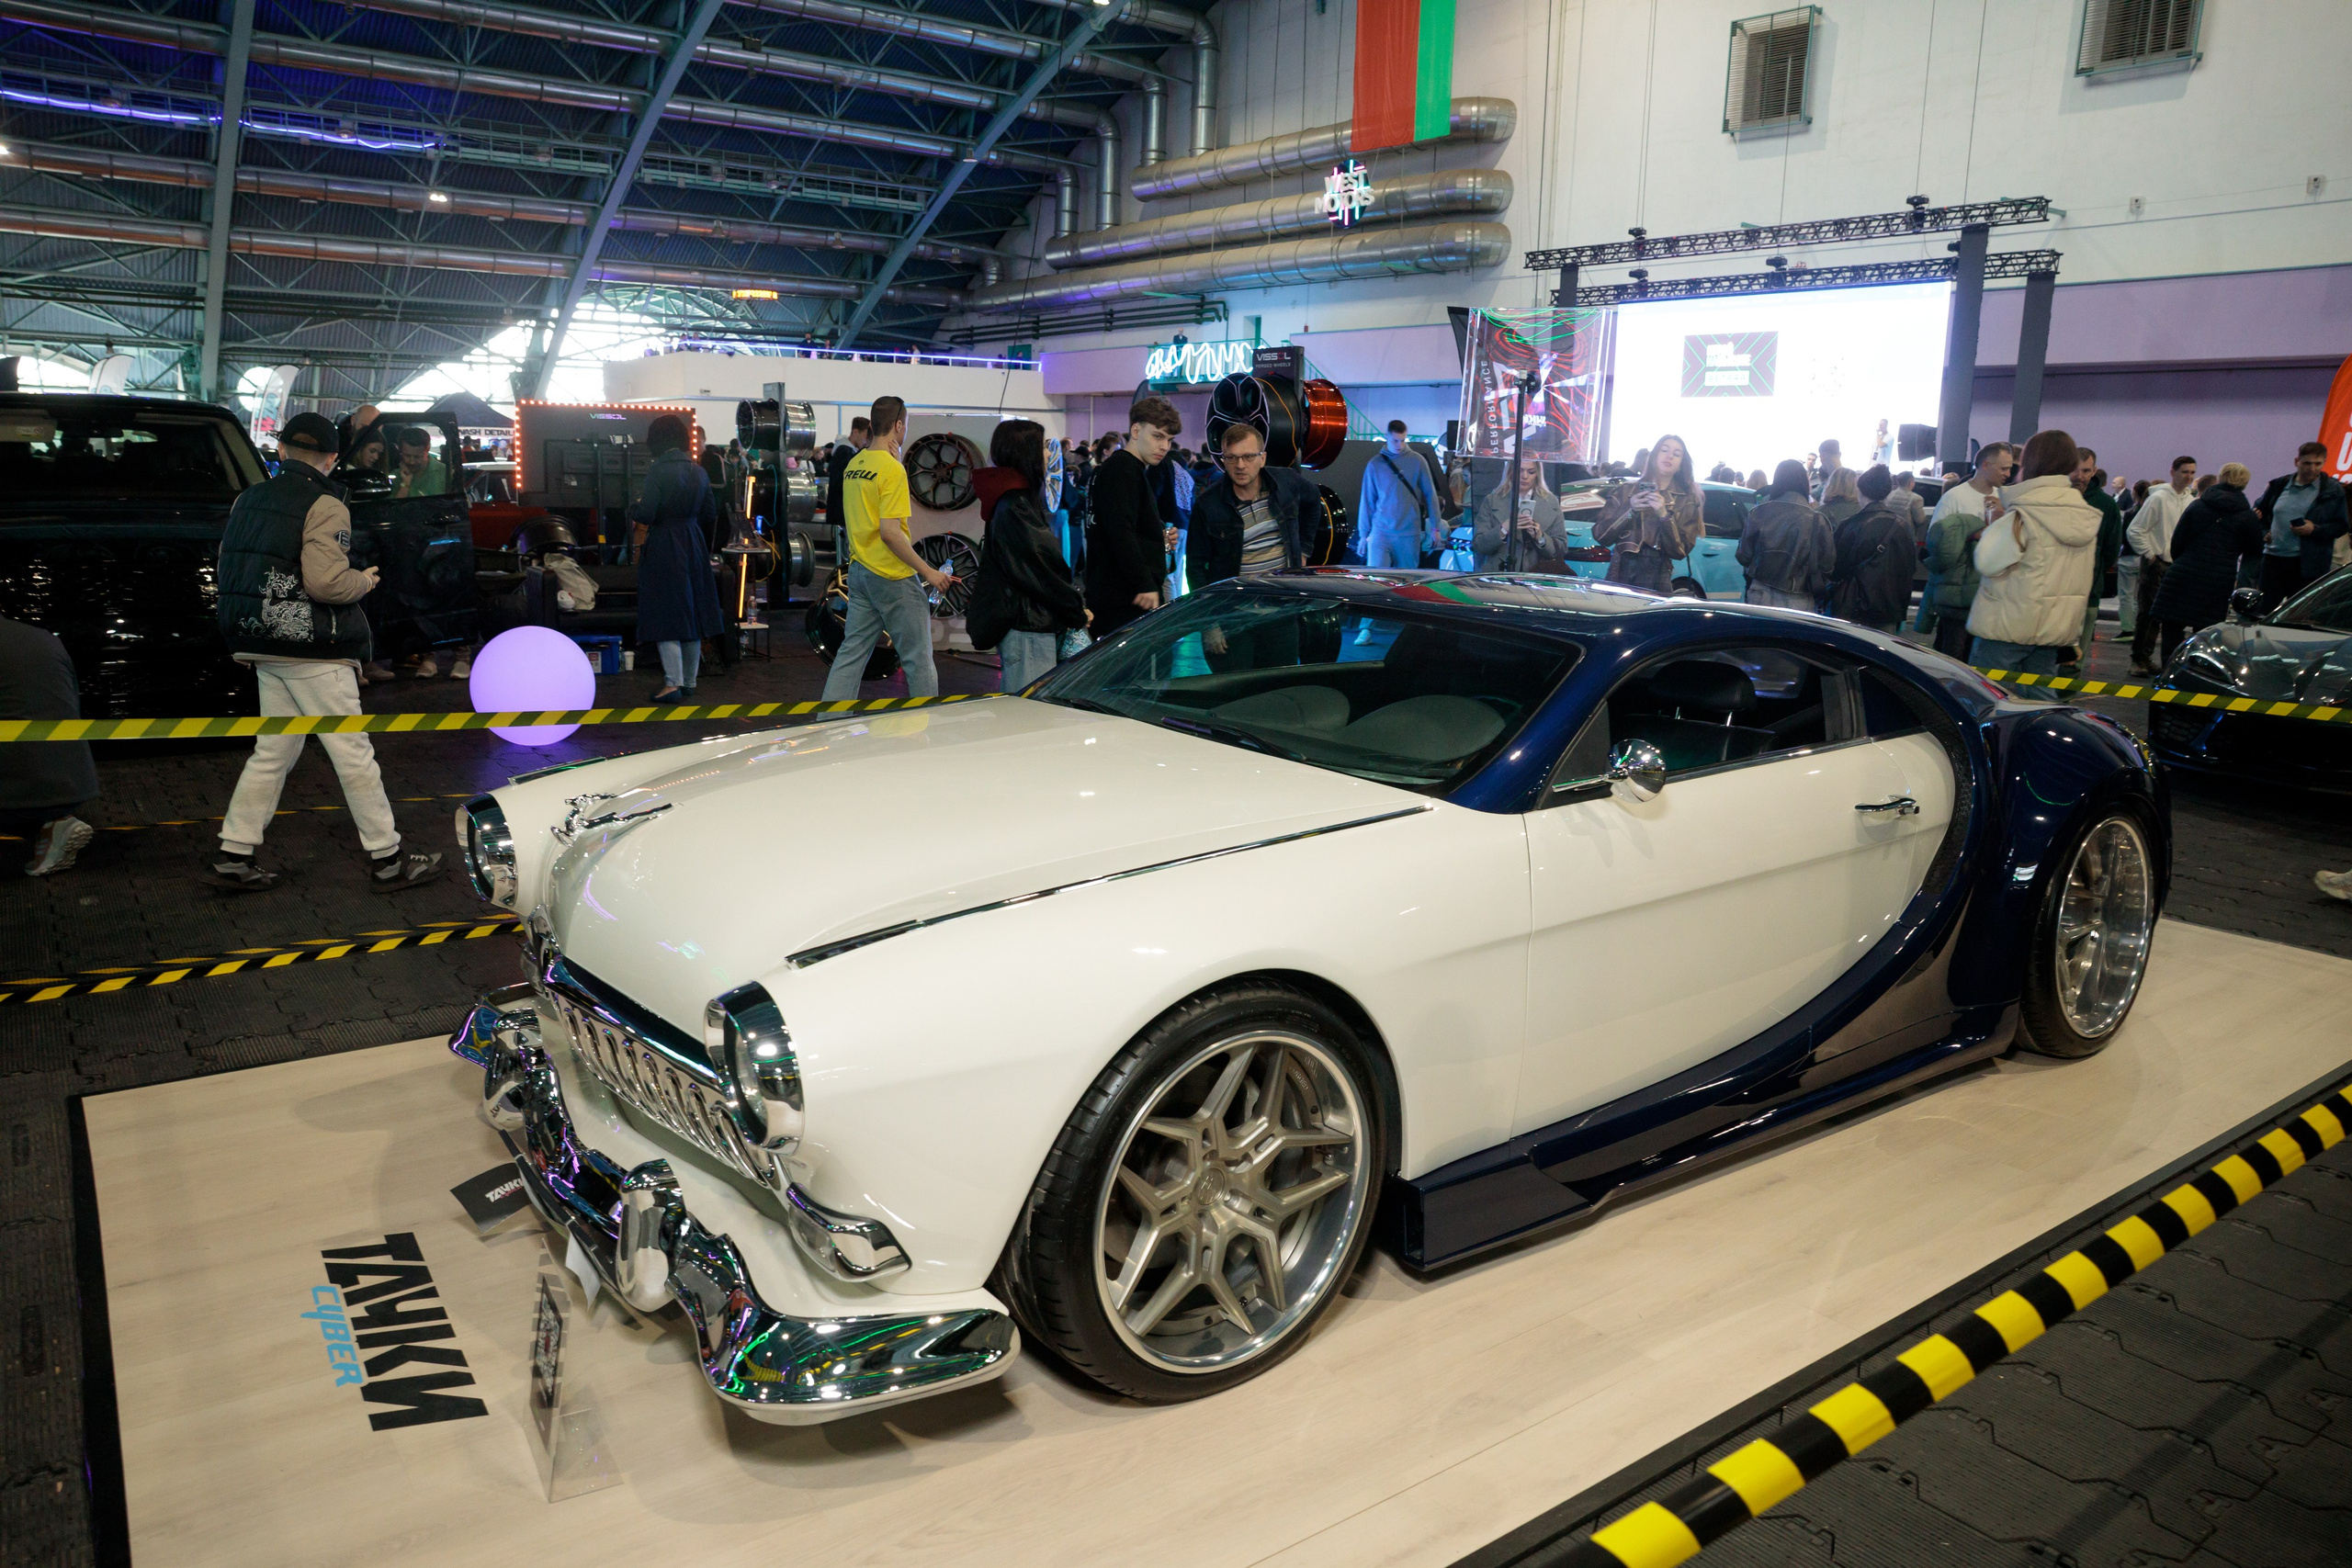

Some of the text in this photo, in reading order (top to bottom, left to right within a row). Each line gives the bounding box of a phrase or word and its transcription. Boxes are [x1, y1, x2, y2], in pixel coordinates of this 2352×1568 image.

[1324, 169, 1368, 193] WEST
[1314, 188, 1375, 214] MOTORS
[1256, 352, 1292, 361] VISSOL
[589, 412, 627, 421] VISSOL
